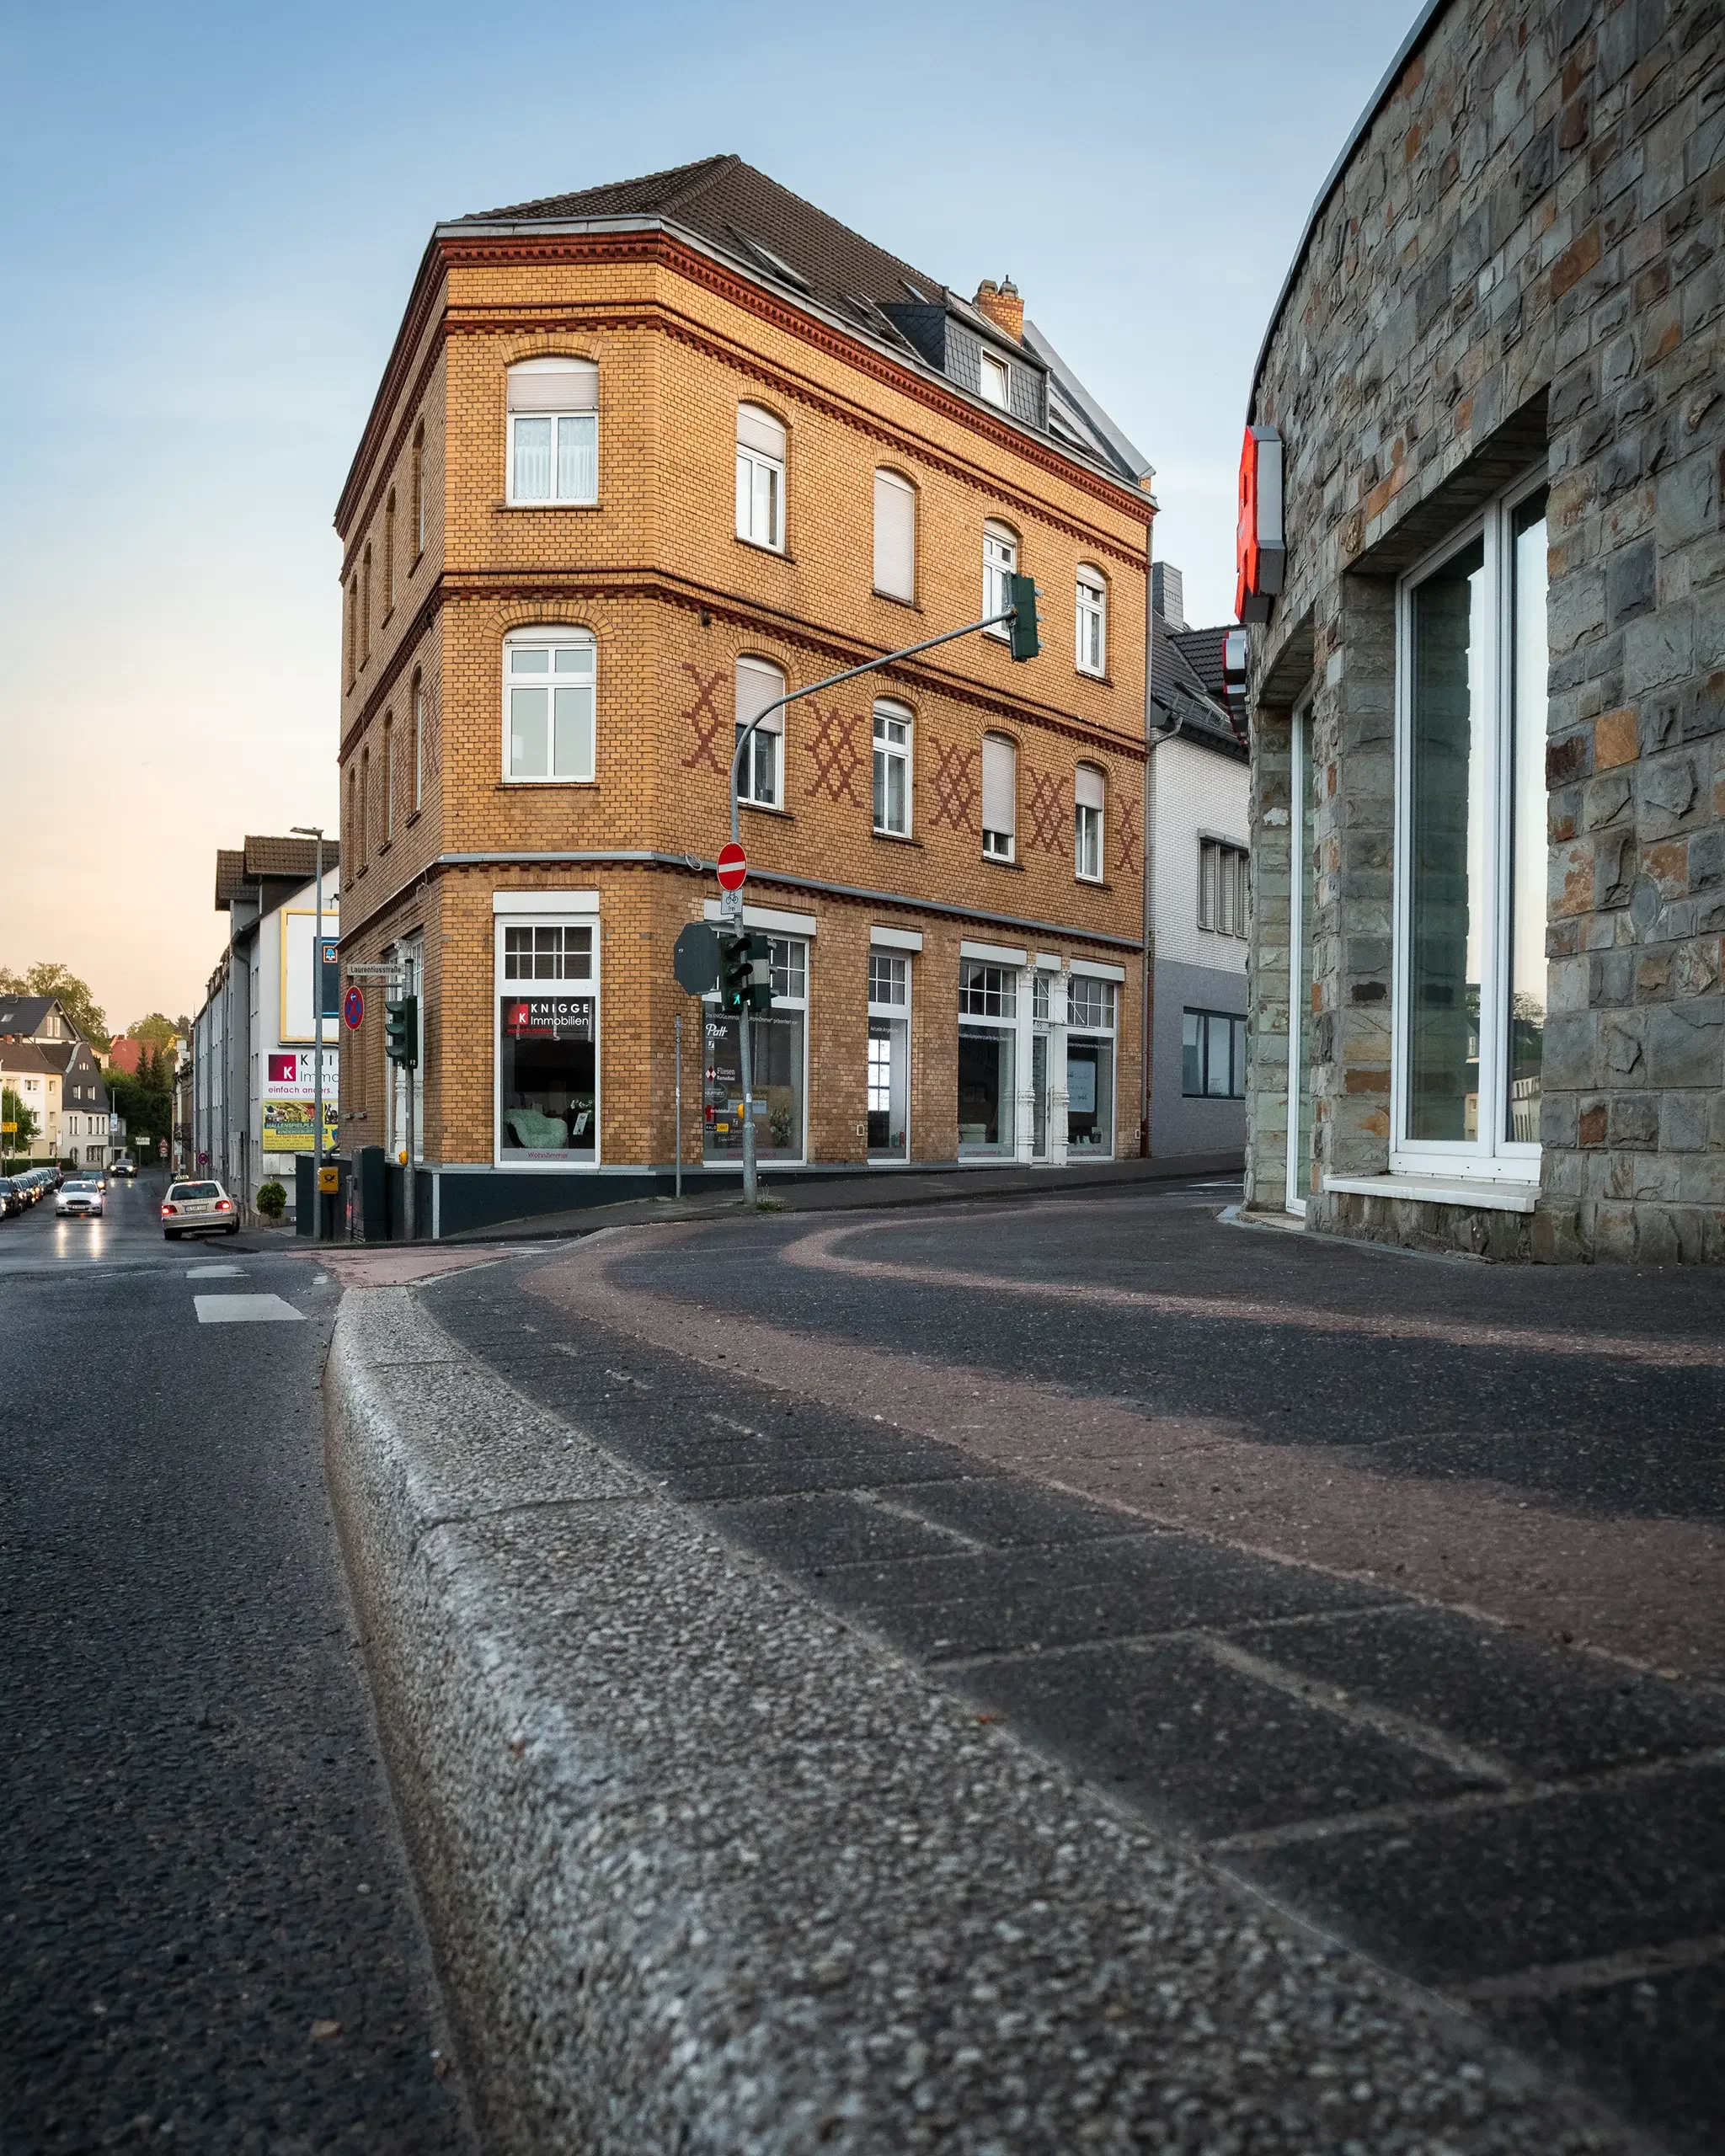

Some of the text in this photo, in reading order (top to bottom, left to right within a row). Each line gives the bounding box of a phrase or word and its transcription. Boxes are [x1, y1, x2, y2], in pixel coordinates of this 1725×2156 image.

[350, 965, 402, 974] Laurentiusstraße
[531, 1003, 589, 1013] KNIGGE
[519, 1012, 526, 1023] K
[531, 1016, 589, 1026] Immobilien
[283, 1066, 293, 1079] K
